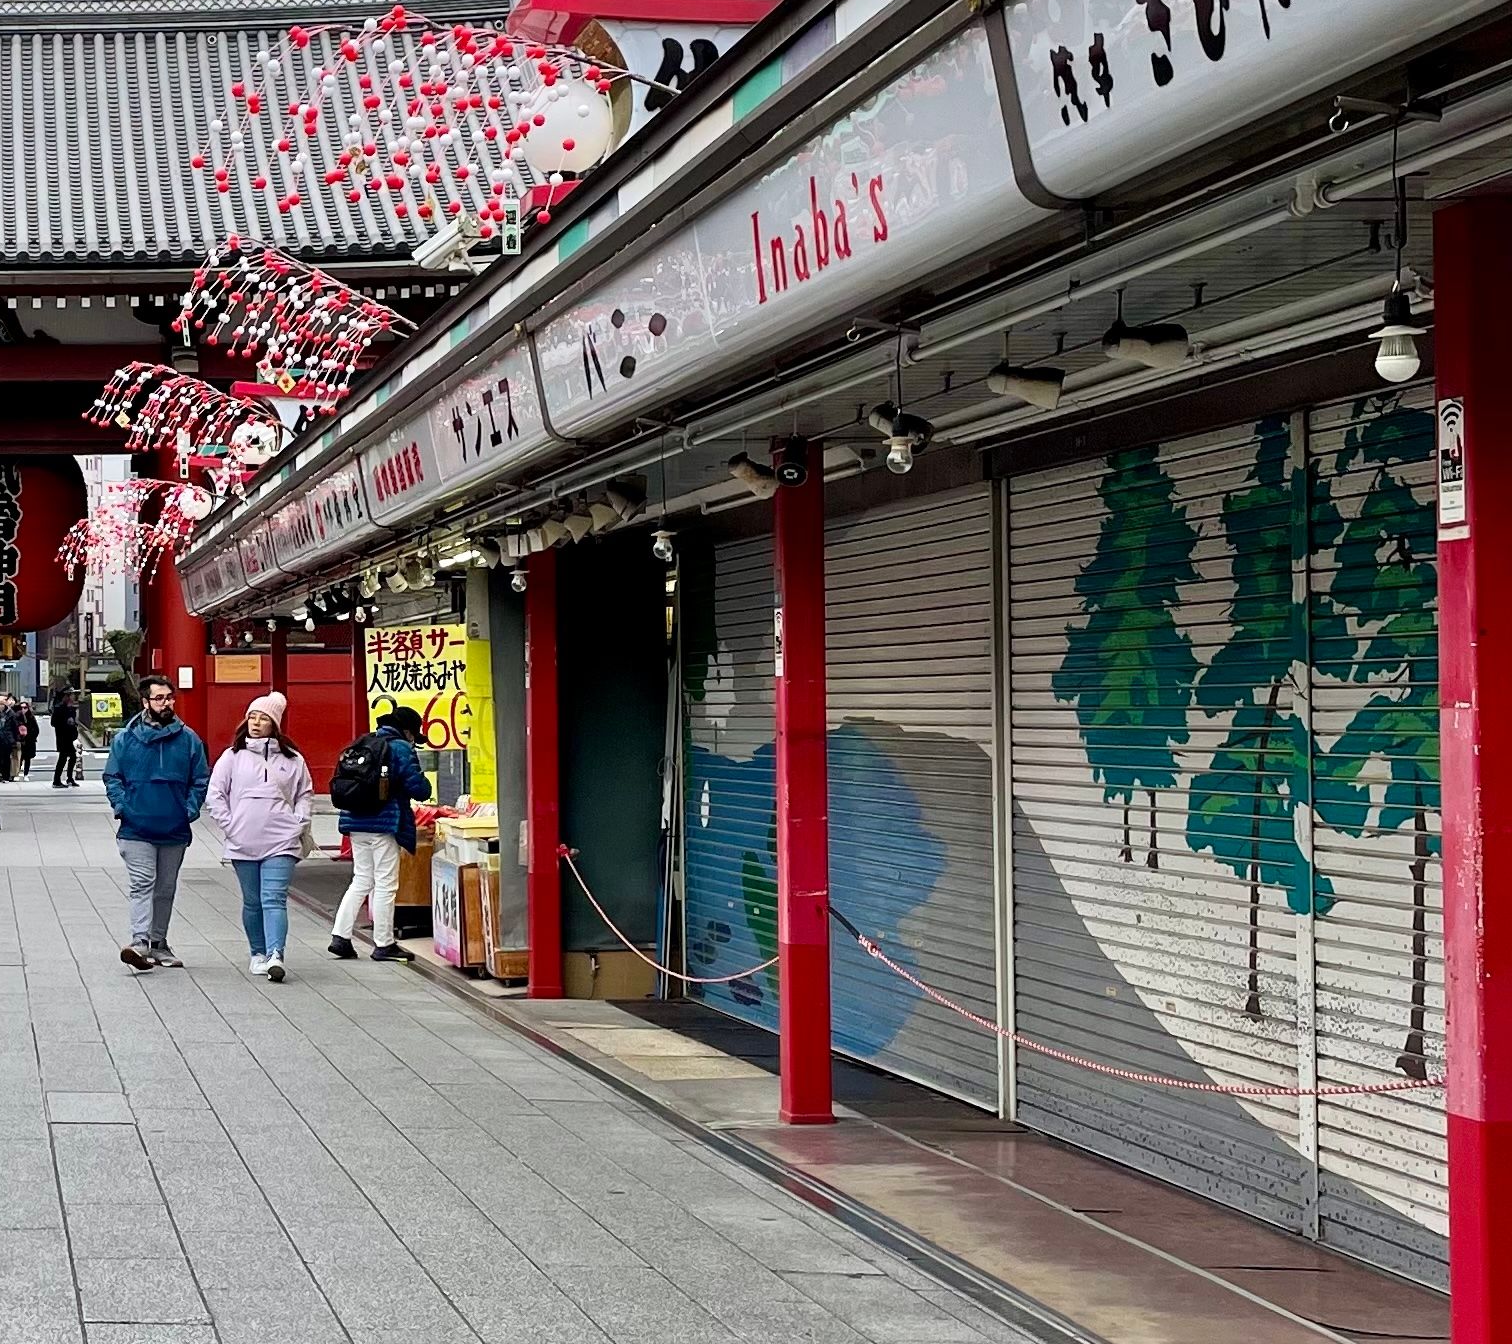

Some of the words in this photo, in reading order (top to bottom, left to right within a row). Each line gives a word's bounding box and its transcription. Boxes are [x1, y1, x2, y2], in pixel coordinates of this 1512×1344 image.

[751, 171, 889, 305] Inaba's
[452, 377, 519, 464] サンエス
